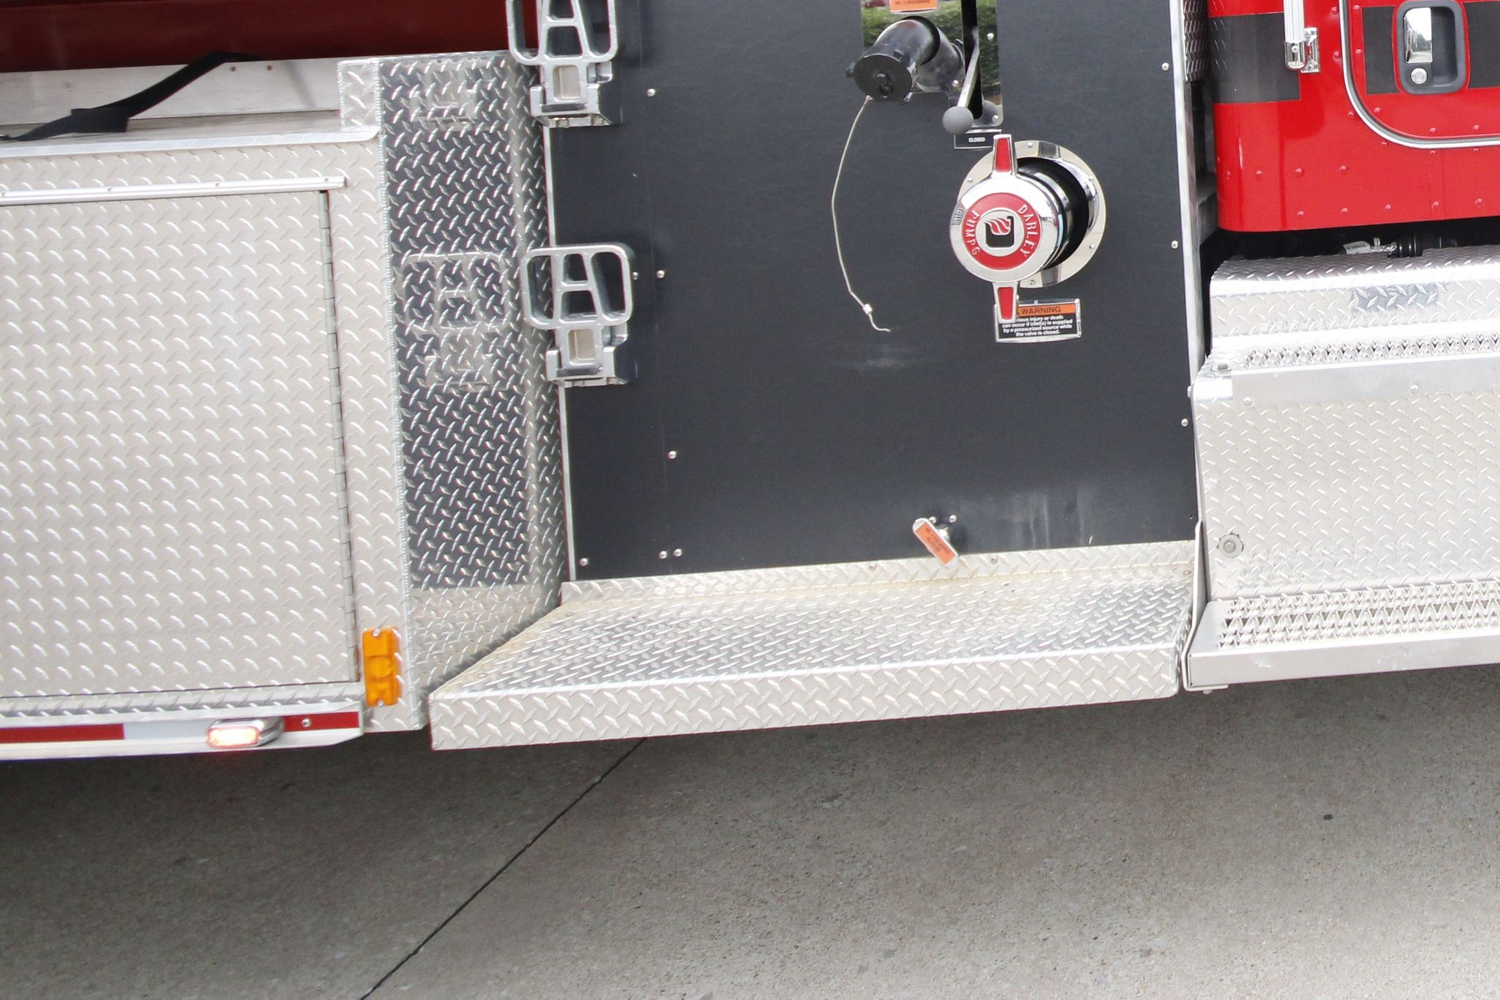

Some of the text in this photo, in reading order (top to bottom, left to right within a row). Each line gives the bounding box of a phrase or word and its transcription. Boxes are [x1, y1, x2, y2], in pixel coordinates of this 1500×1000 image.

[965, 208, 980, 256] PUMPS
[1017, 203, 1038, 258] DARLEY
[1021, 307, 1061, 315] WARNING
[1052, 318, 1073, 326] supplied
